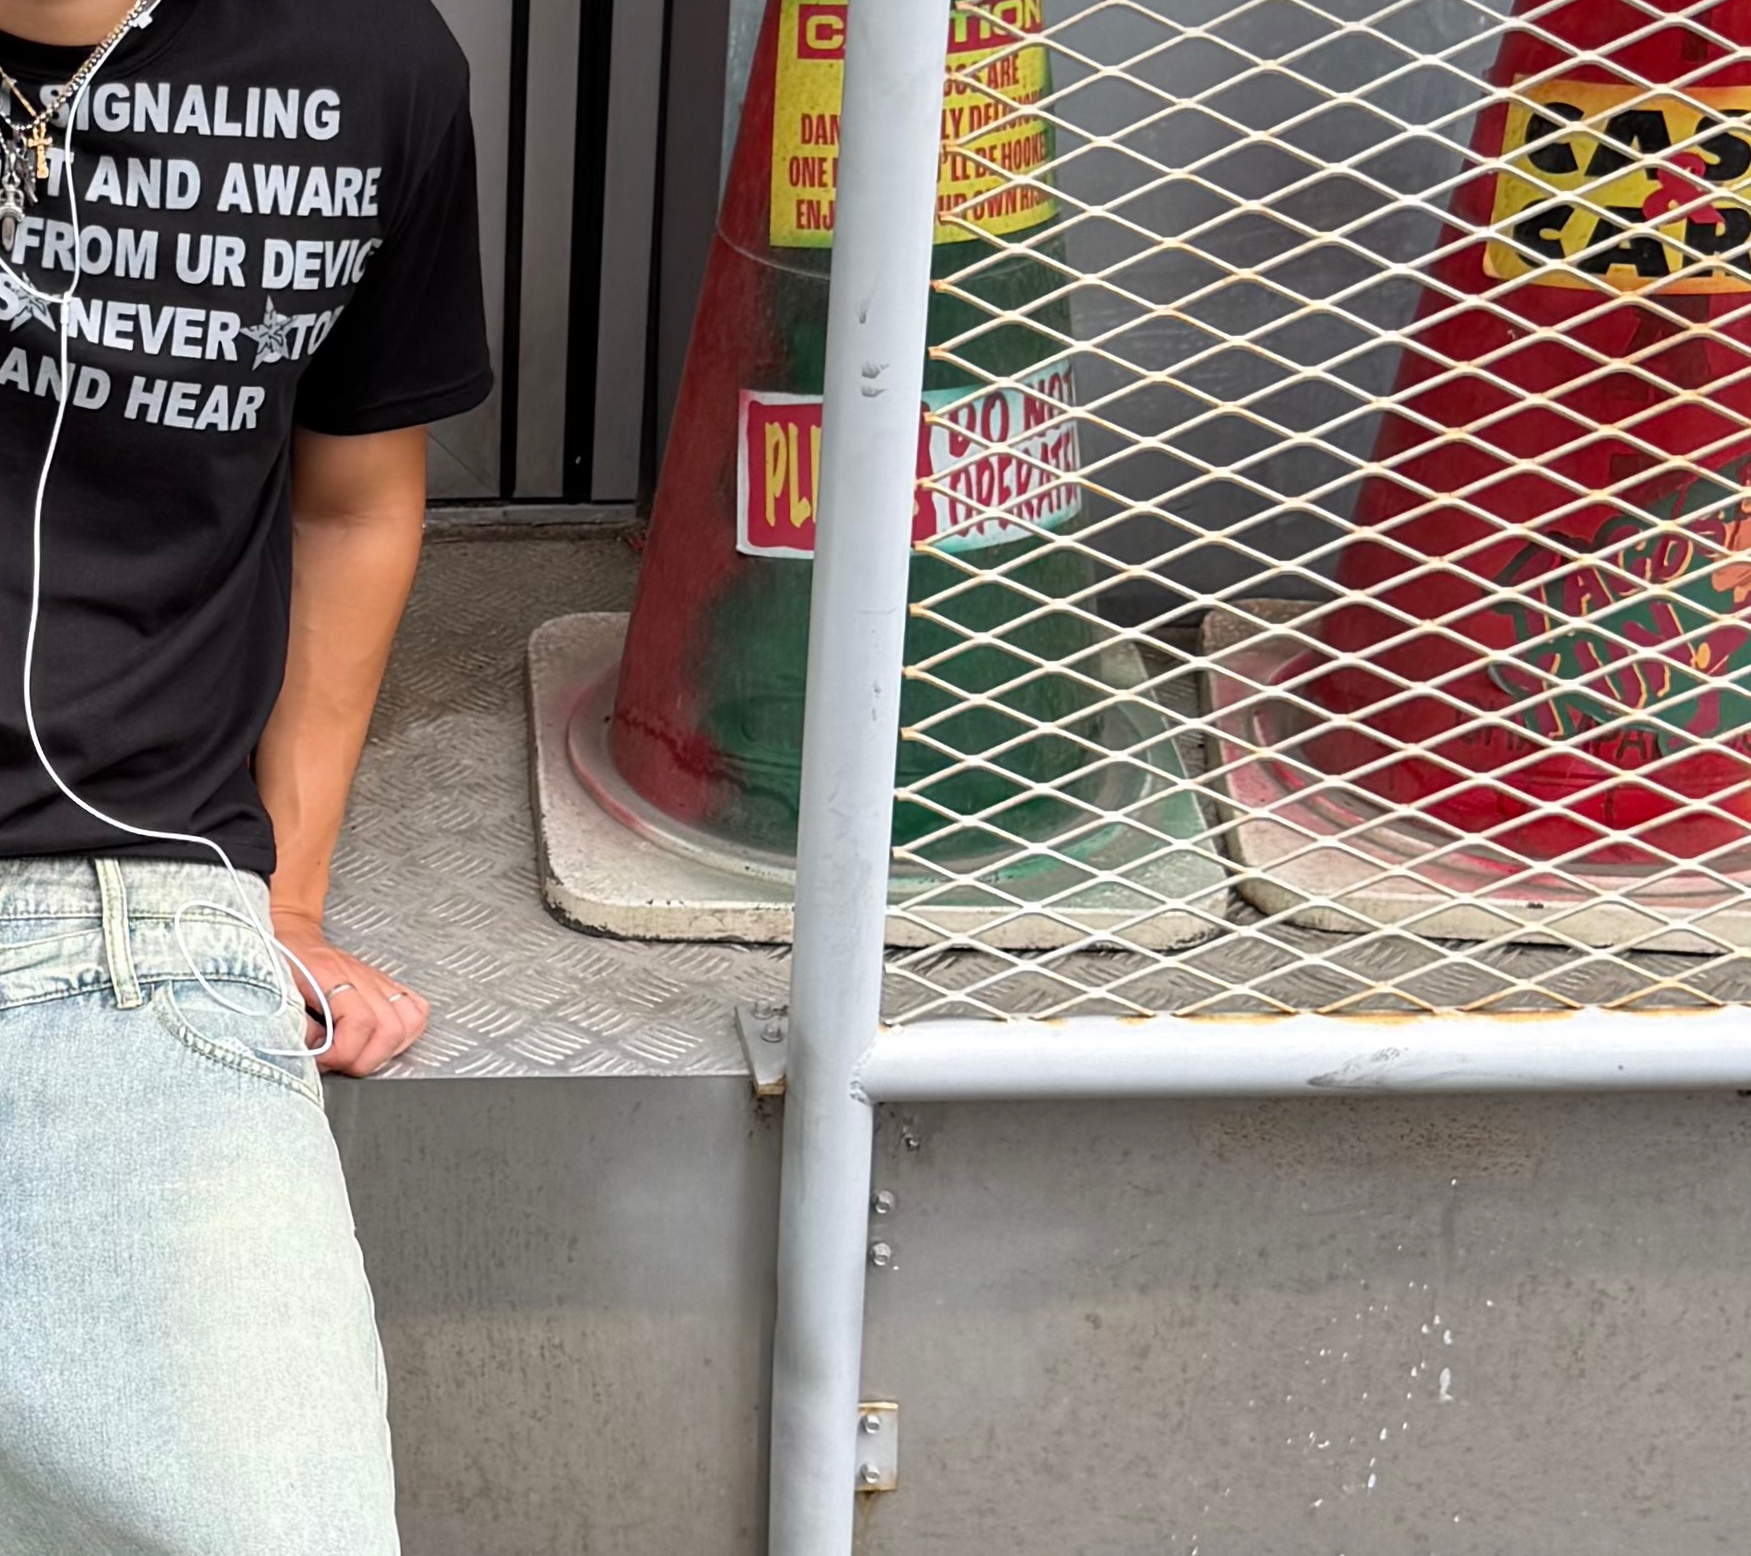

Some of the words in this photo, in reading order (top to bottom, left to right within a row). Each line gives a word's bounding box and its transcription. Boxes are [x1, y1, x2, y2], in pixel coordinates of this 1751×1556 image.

[988, 52, 1020, 90] ARE
[40, 83, 340, 140] SIGNALING
[86, 155, 201, 210] AND
[217, 162, 382, 217] AWARE
[789, 156, 827, 189] ONE
[11, 216, 158, 281] FROM
[176, 232, 246, 288] UR
[67, 297, 241, 361] NEVER
[123, 375, 266, 432] HEAR
[949, 391, 1009, 458] DO
